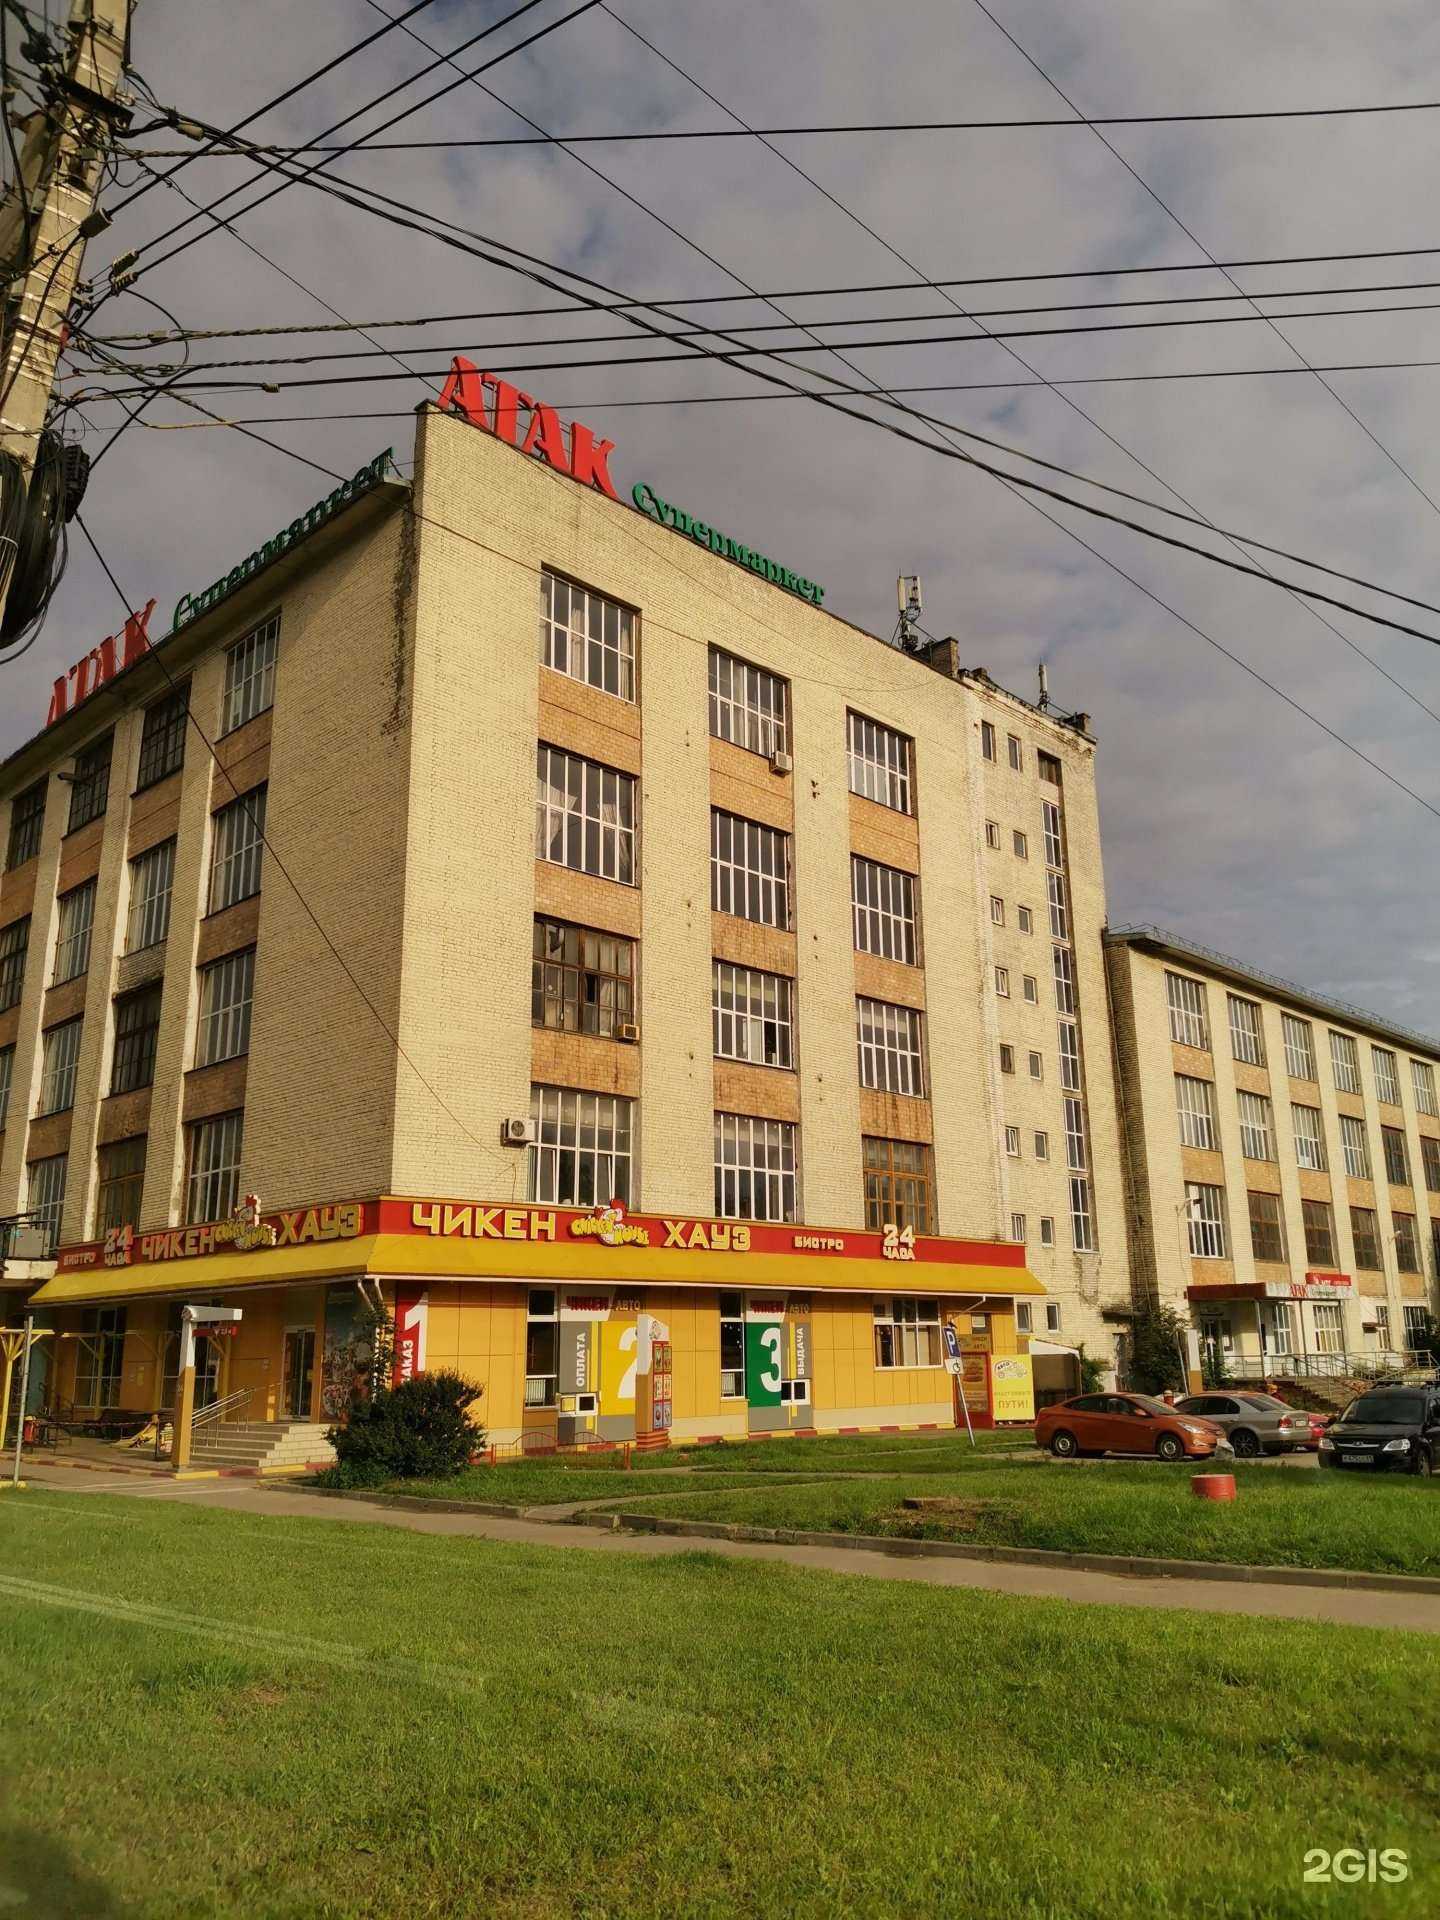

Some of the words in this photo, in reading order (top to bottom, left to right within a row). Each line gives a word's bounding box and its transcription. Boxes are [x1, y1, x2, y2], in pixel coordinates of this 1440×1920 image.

[438, 356, 618, 500] АТАК
[632, 482, 825, 605] Супермаркет
[141, 1226, 216, 1261] ЧИКЕН
[277, 1204, 365, 1246] ХАУЗ
[412, 1203, 556, 1240] ЧИКЕН
[663, 1220, 751, 1251] ХАУЗ
[883, 1224, 915, 1248] 24
[405, 1292, 428, 1371] 1
[797, 1327, 805, 1375] ВЫДАЧА
[401, 1340, 413, 1384] АКАЗ
[576, 1332, 586, 1387] ОПЛАТА
[761, 1327, 782, 1392] 3
